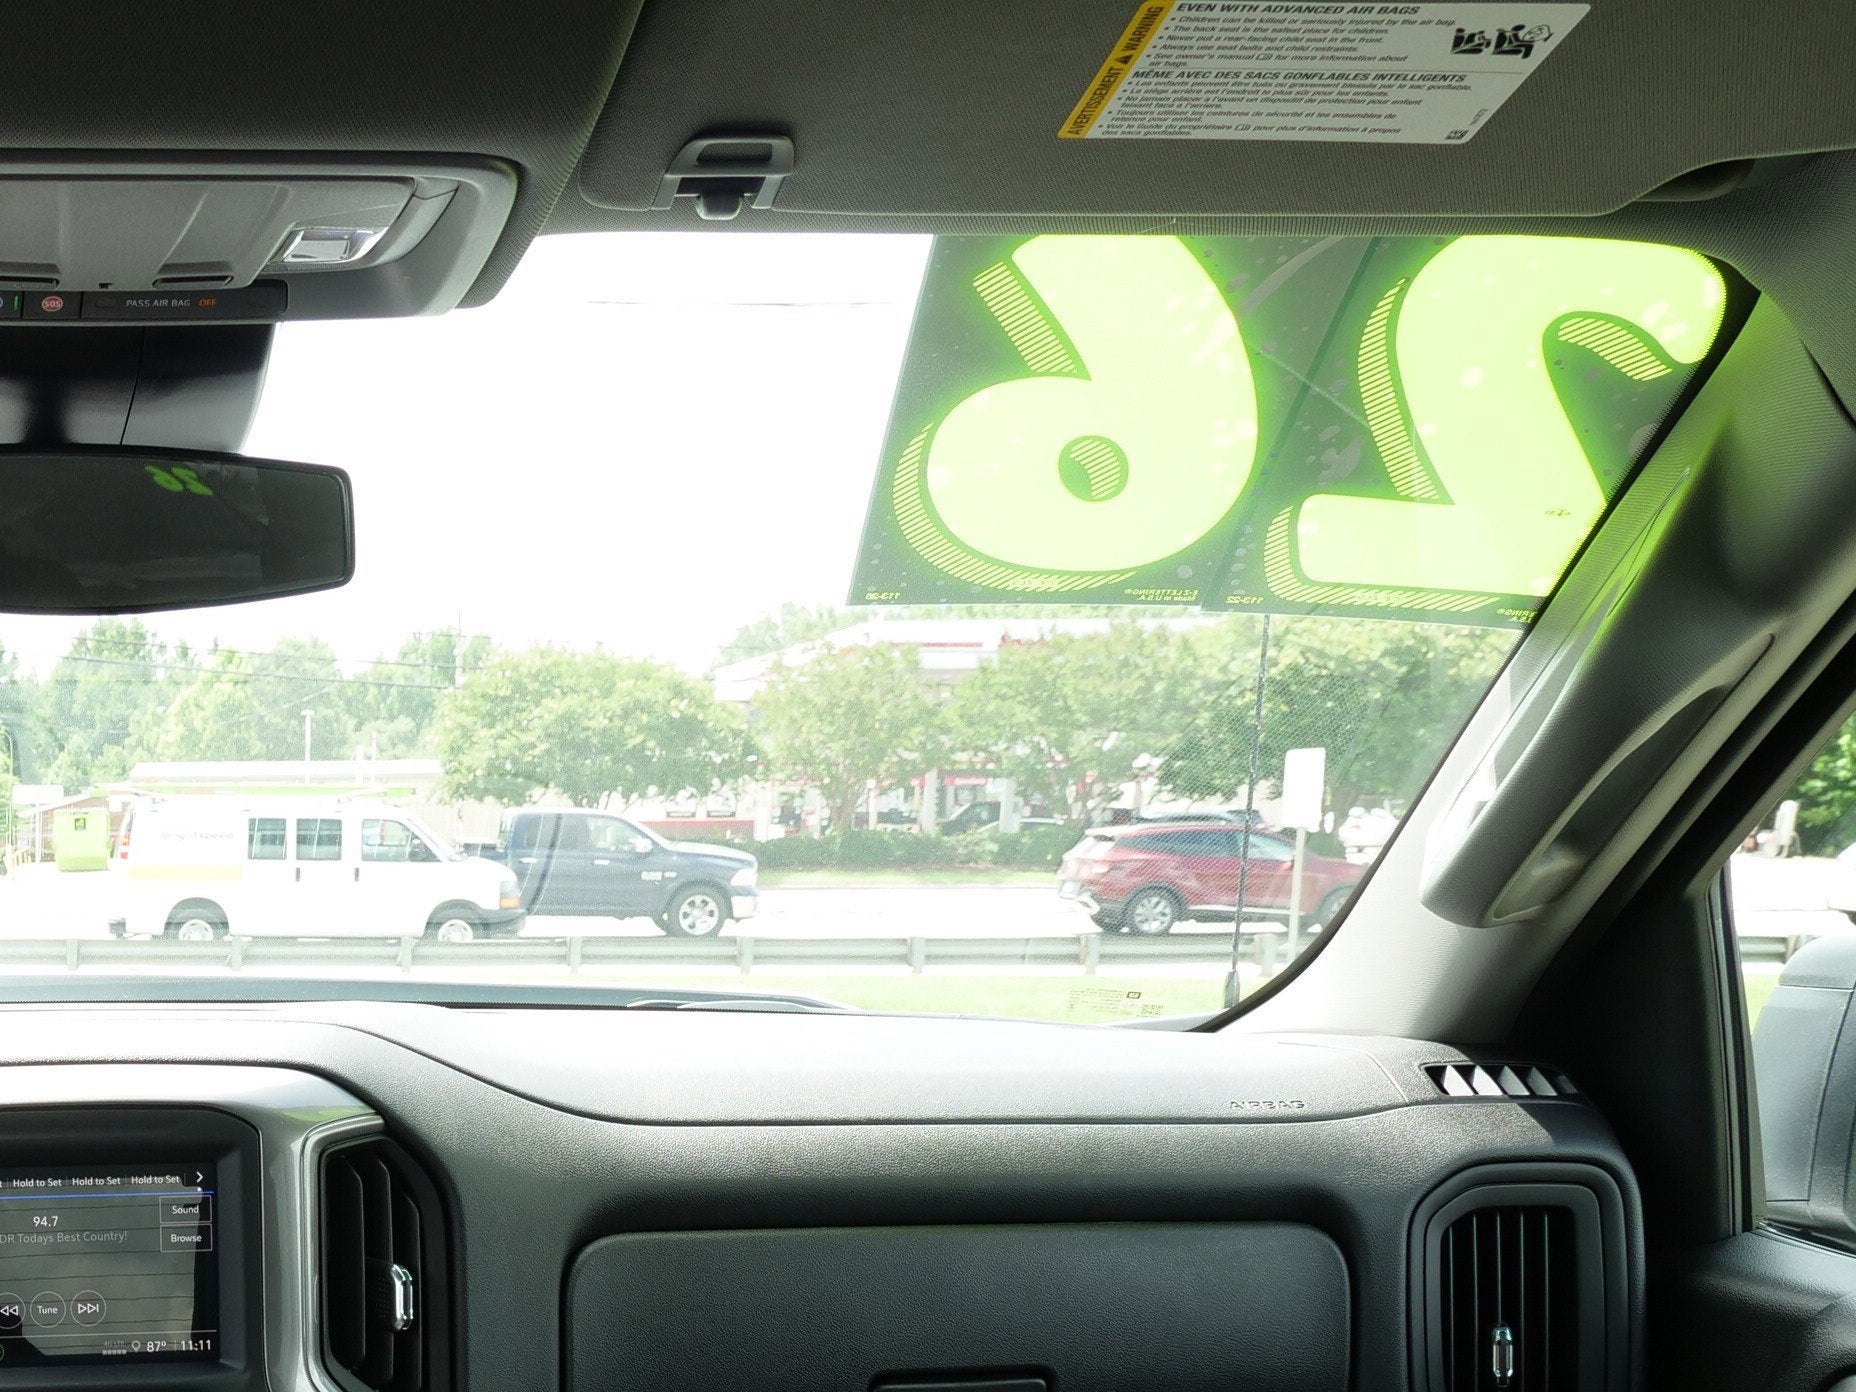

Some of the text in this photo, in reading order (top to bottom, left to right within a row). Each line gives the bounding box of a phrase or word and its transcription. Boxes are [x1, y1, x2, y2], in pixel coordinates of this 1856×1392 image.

[1177, 4, 1420, 15] EVEN WITH ADVANCED AIR BAGS
[1122, 6, 1164, 52] WARNING
[1132, 69, 1467, 82] MÊME AVEC DES SACS GONFLABLES INTELLIGENTS
[1067, 66, 1124, 135] AVERTISSEMENT
[126, 299, 217, 307] PASS AIR BAG OFF
[1231, 1100, 1305, 1109] AIRBAG
[13, 1178, 62, 1187] Hold to Set
[72, 1177, 121, 1186] Hold to Set
[131, 1175, 180, 1184] Hold to Set
[172, 1205, 199, 1214] Sound
[32, 1216, 58, 1227] 94.7
[17, 1233, 54, 1246] Todays
[57, 1232, 80, 1243] Best
[83, 1230, 128, 1244] Country!
[171, 1233, 202, 1243] Browse
[37, 1306, 58, 1314] Tune
[147, 1341, 167, 1352] 87°
[181, 1340, 211, 1351] 11:11
